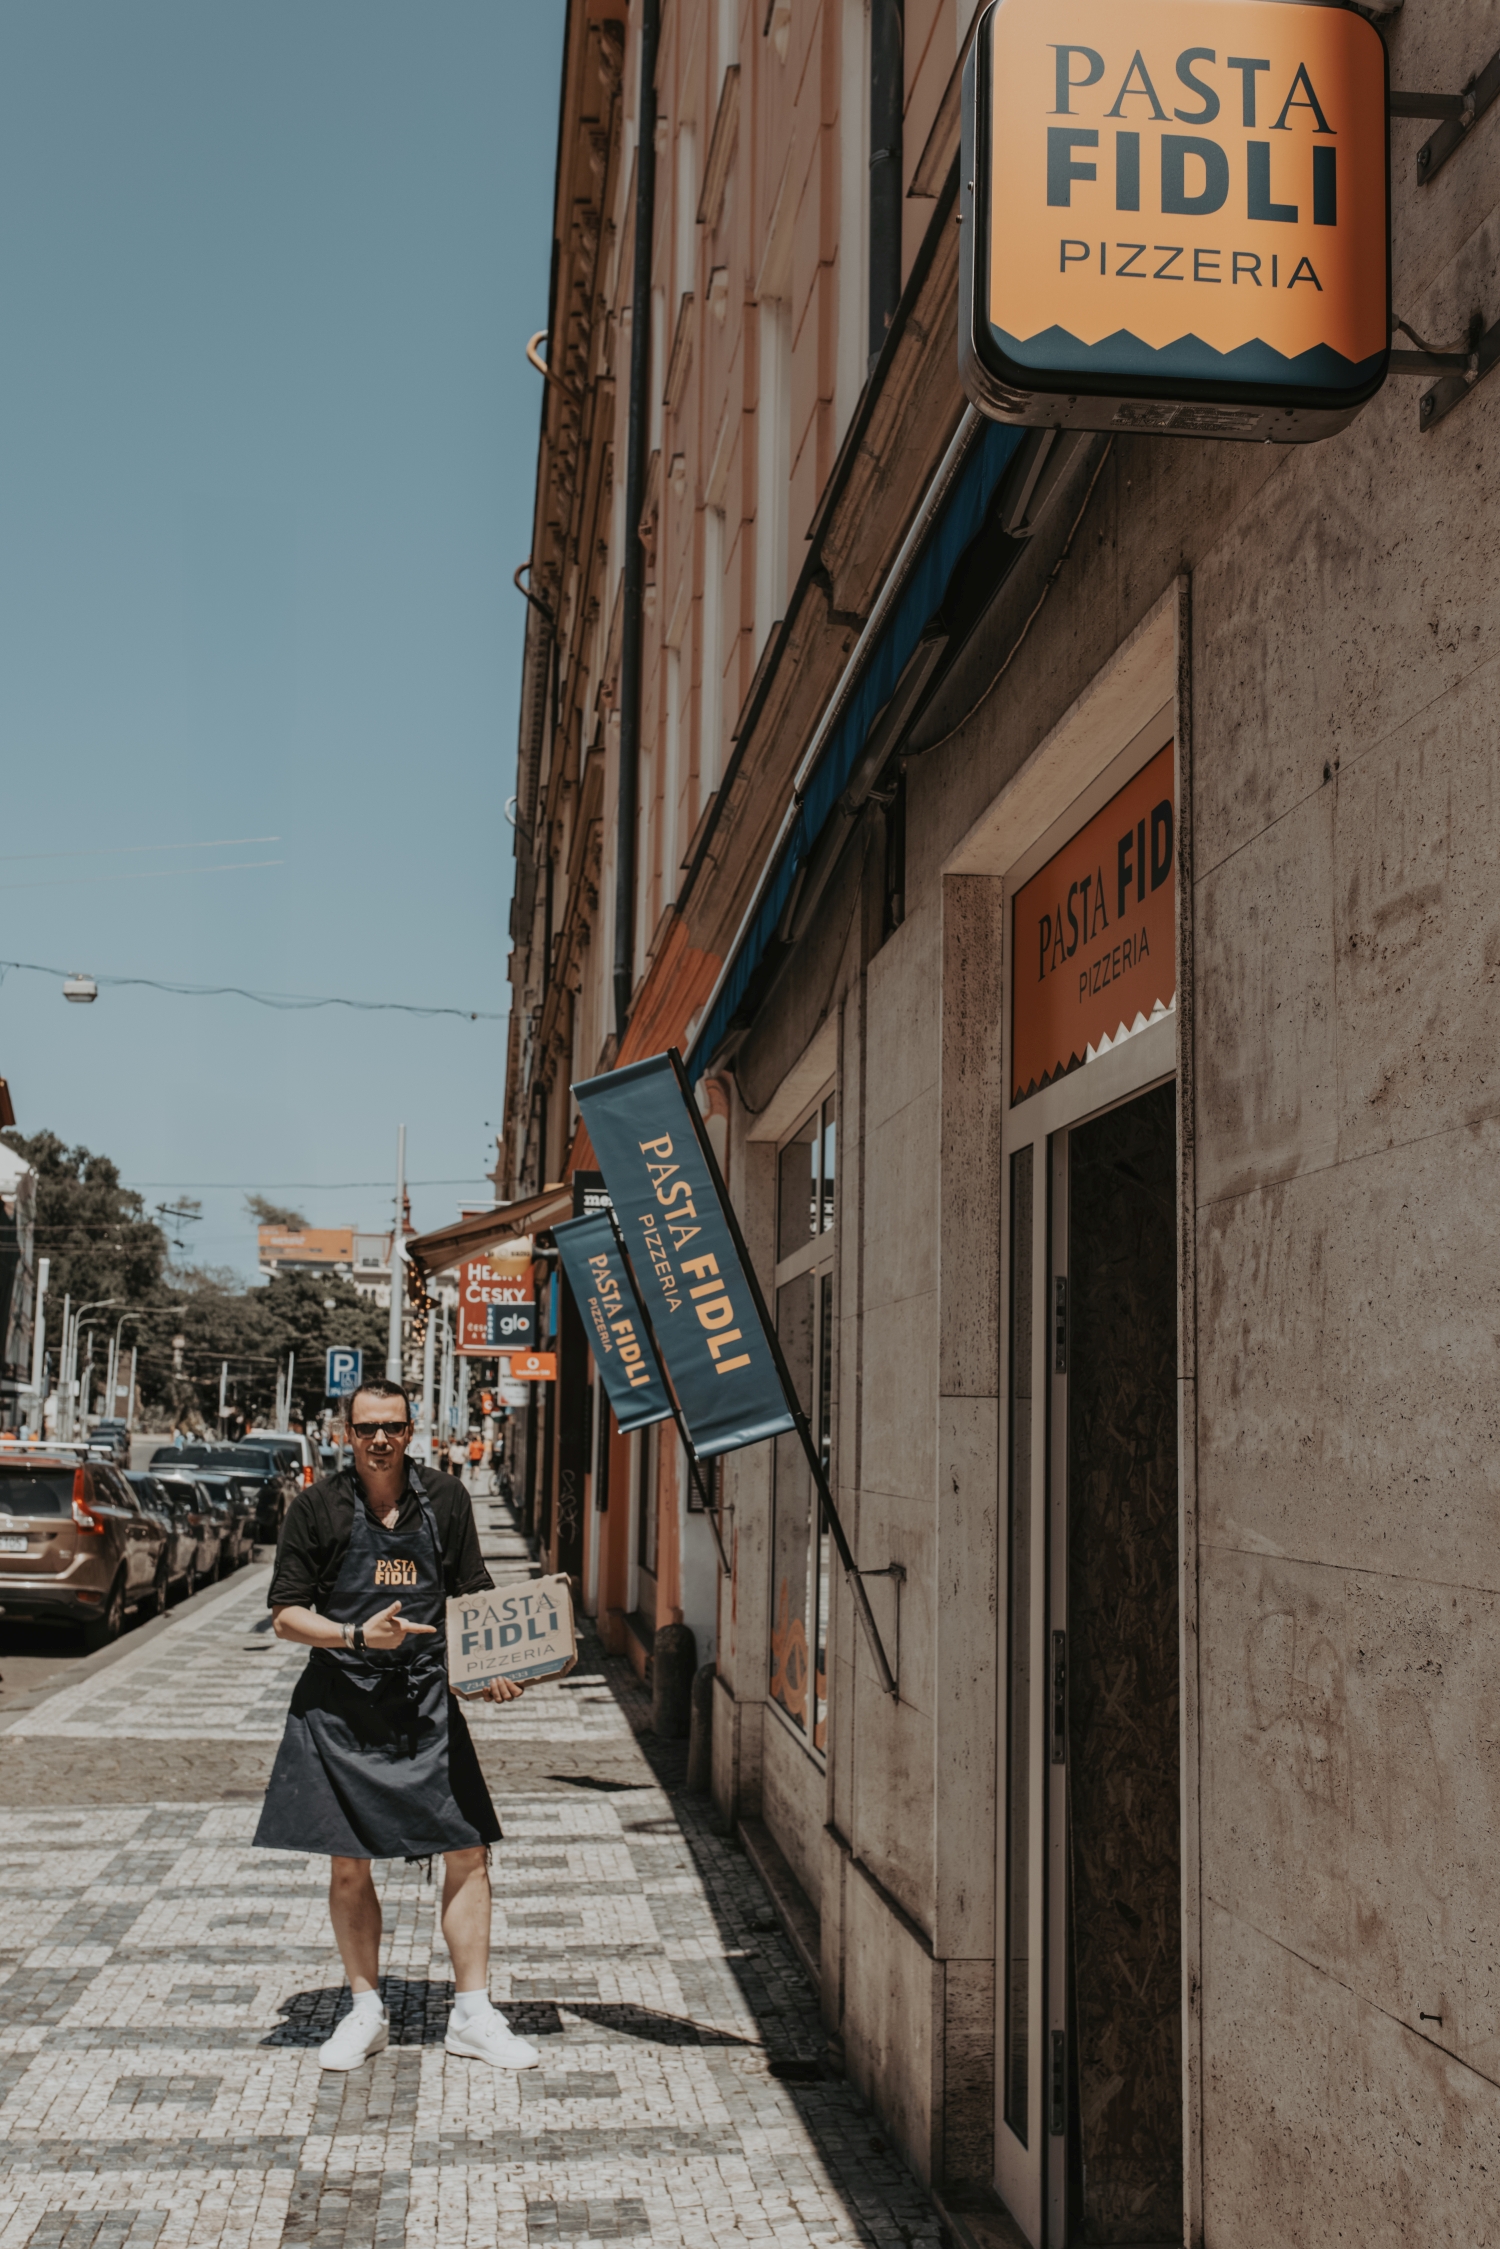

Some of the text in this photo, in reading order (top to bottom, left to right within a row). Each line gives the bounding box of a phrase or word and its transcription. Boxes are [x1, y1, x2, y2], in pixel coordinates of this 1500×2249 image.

[1046, 44, 1338, 135] PASTA
[1046, 126, 1338, 227] FIDLI
[1059, 239, 1324, 292] PIZZERIA
[1037, 865, 1110, 983] PASTA
[1079, 925, 1150, 1004] PIZZERIA
[638, 1131, 751, 1375] PASTA FIDLI
[638, 1213, 682, 1313] PIZZERIA
[500, 1313, 530, 1335] glo
[587, 1297, 613, 1354] PIZZERIA
[588, 1253, 624, 1319] PASTA
[610, 1318, 651, 1388] FIDLI
[333, 1353, 355, 1382] P
[374, 1571, 417, 1585] FIDLI
[376, 1558, 418, 1572] PASTA
[461, 1611, 559, 1656] FIDLI
[462, 1591, 556, 1631] PASTA
[467, 1644, 556, 1673] PIZZERIA
